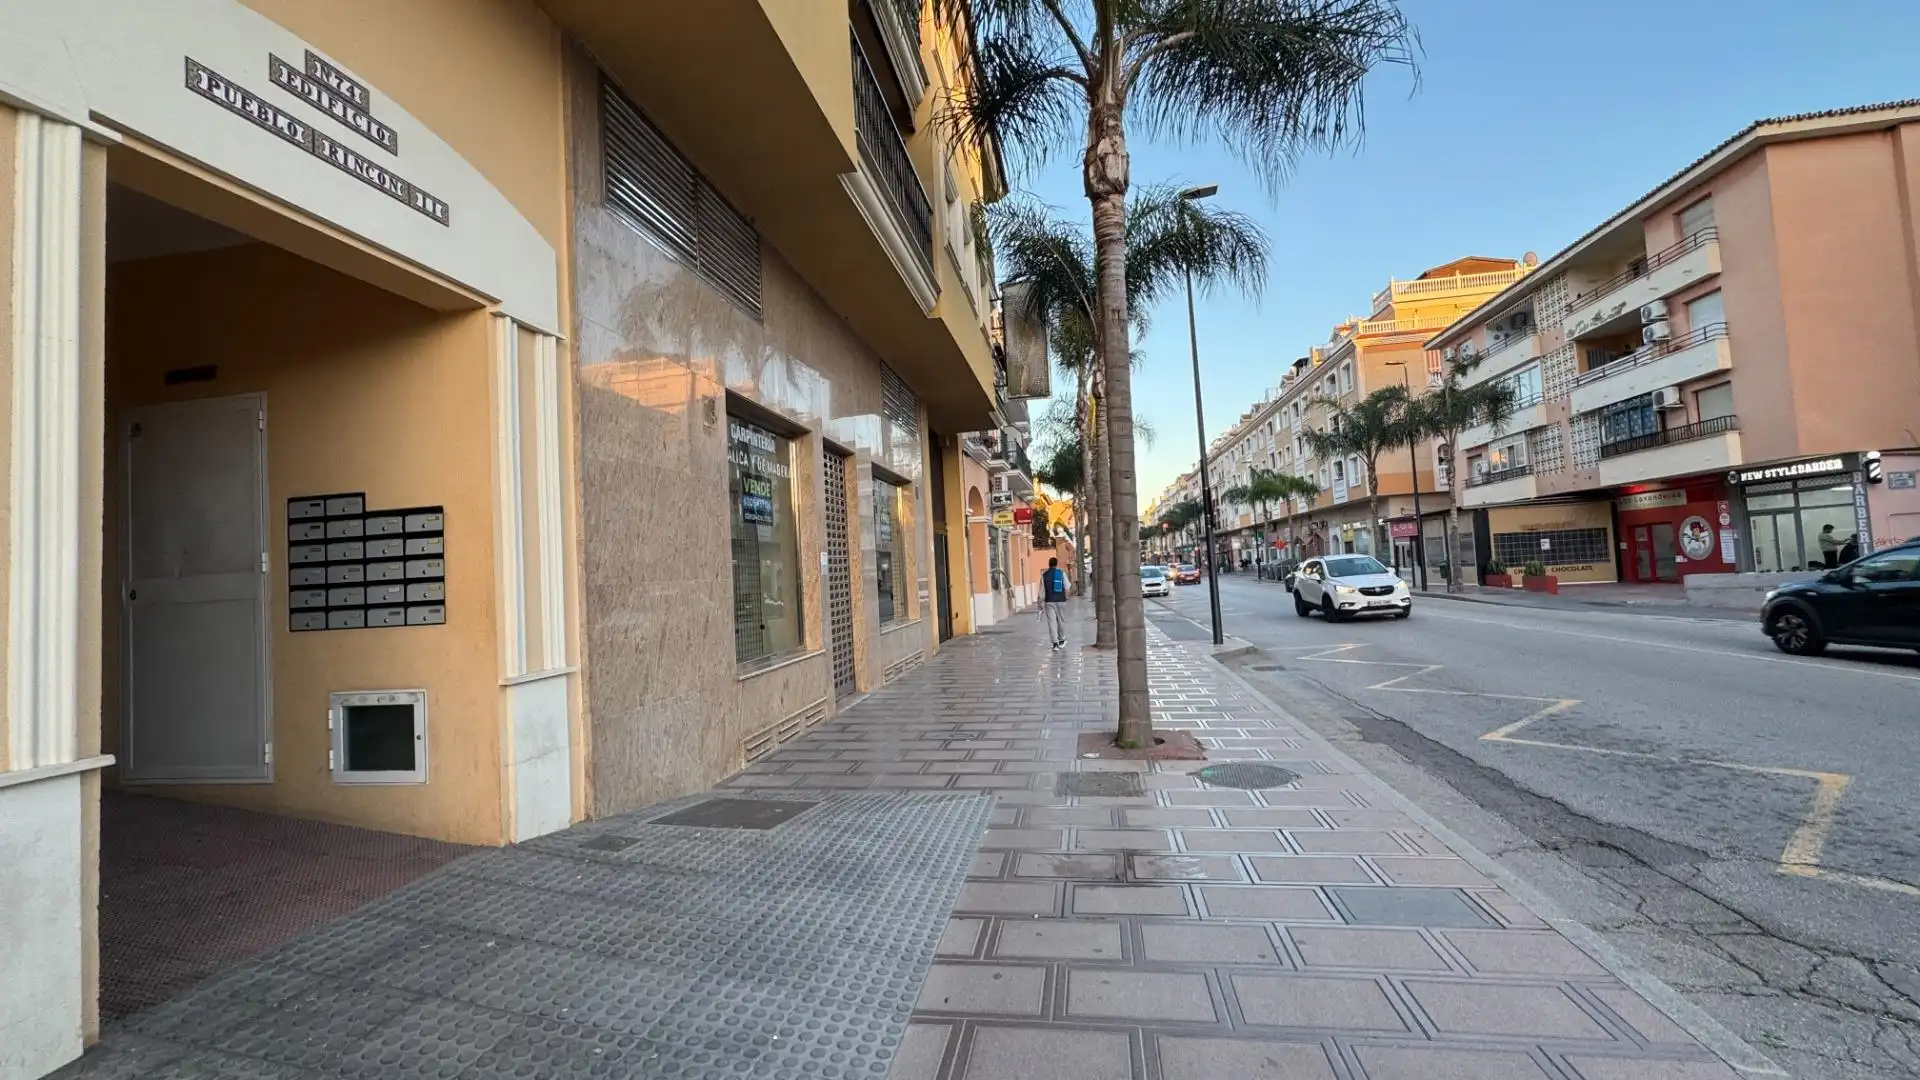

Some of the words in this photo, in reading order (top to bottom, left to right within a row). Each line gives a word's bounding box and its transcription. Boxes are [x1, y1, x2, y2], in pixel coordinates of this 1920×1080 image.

[287, 70, 386, 142] EDIFICIO
[206, 75, 298, 139] PUEBLO
[328, 144, 399, 195] RINCON
[743, 477, 771, 497] VENDE
[1741, 470, 1763, 481] NEW
